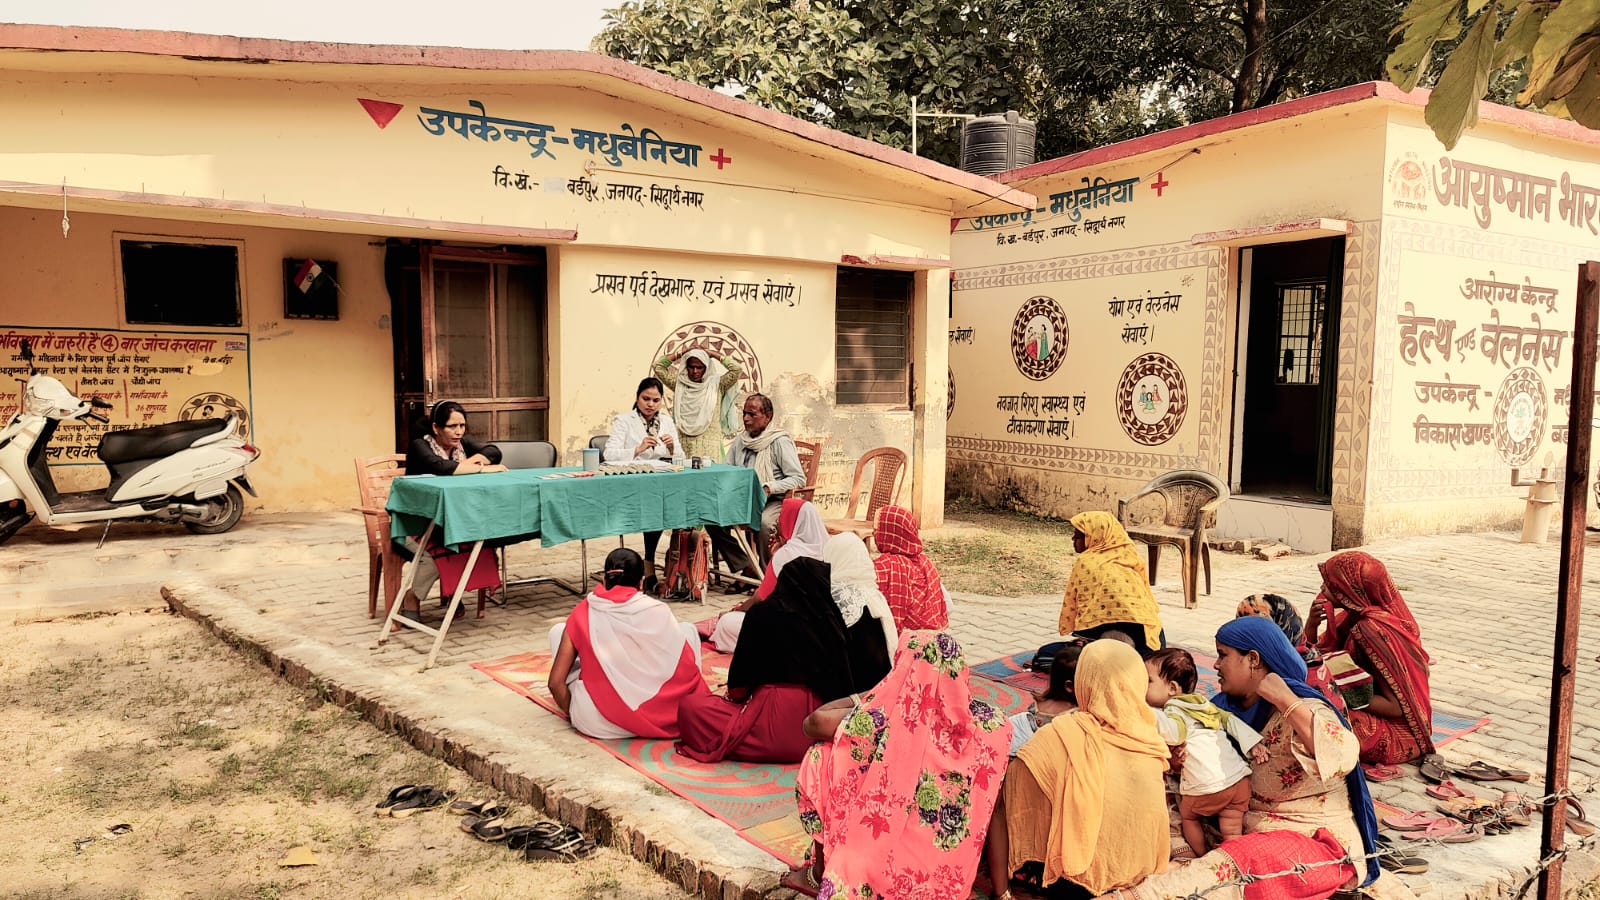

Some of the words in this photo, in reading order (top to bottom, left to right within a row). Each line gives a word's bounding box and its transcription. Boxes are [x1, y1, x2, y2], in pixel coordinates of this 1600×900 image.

[1432, 156, 1557, 229] आयुष्मान
[1559, 172, 1600, 236] भार
[590, 273, 627, 296] प्रसव
[703, 276, 726, 304] एवं
[726, 281, 759, 302] प्रसव
[1108, 296, 1126, 318] योग
[1127, 294, 1144, 319] एवं
[1145, 289, 1182, 317] वेलनेस
[1459, 271, 1520, 305] आरोग्य
[1521, 276, 1559, 314] केन्द्र
[121, 337, 140, 353] बार
[1397, 302, 1456, 367] हेल्थ
[1480, 309, 1567, 373] वेलनेस
